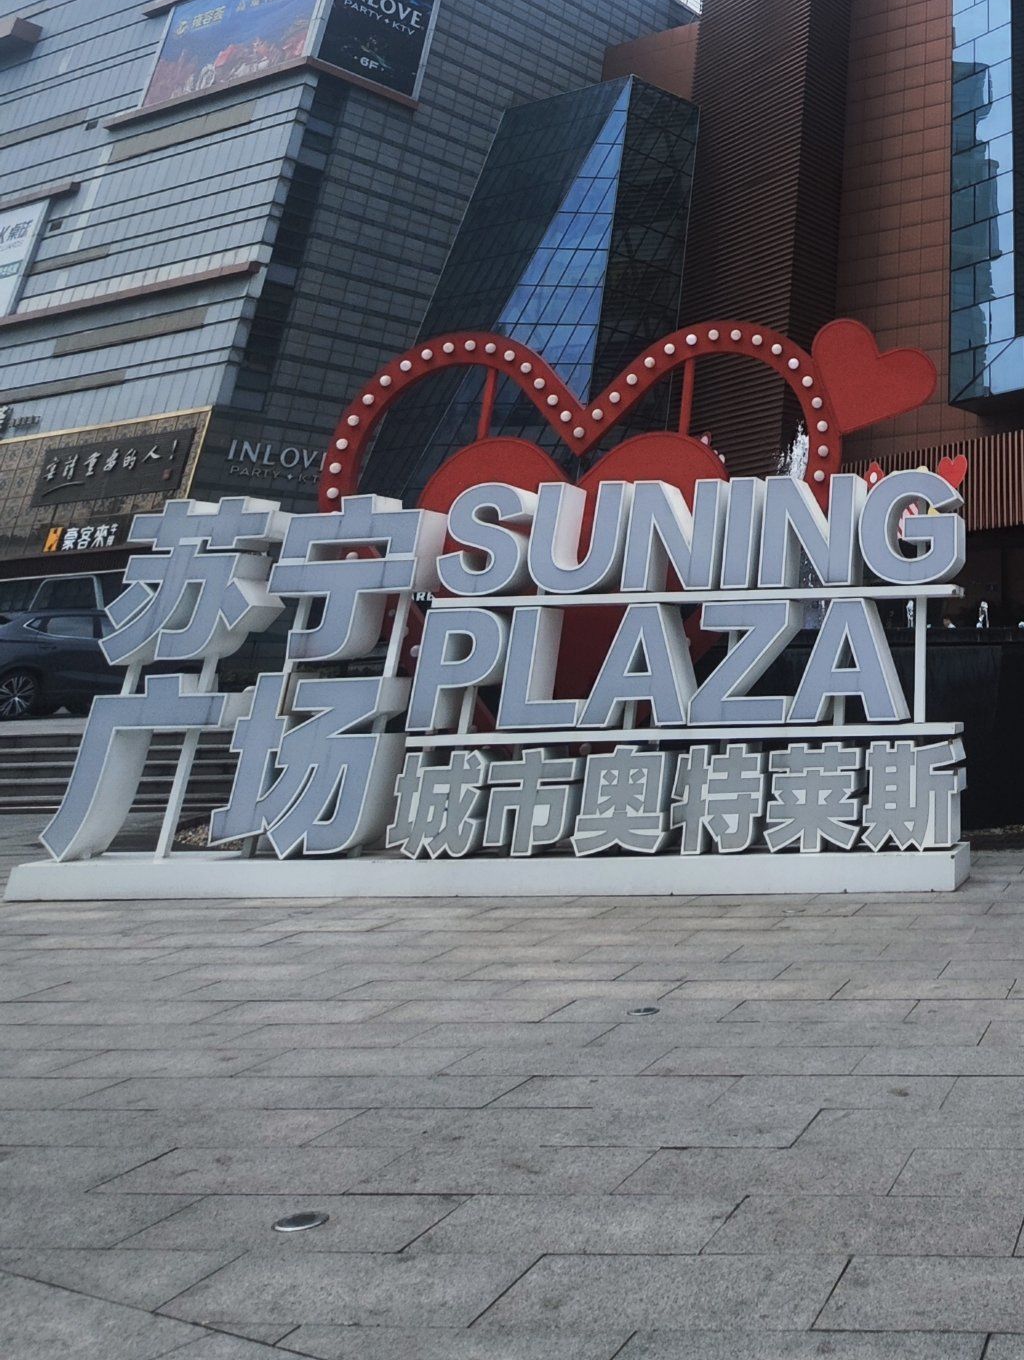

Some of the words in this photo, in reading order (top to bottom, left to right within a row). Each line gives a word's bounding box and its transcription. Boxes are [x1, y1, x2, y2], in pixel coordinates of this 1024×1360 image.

[359, 56, 380, 70] 6F
[391, 21, 416, 36] KTV
[229, 465, 281, 479] PARTY
[436, 470, 966, 597] SUNING
[100, 493, 424, 666] 苏宁
[405, 598, 911, 732] PLAZA
[39, 671, 385, 863] 广场
[385, 740, 968, 860] 城市奥特莱斯
